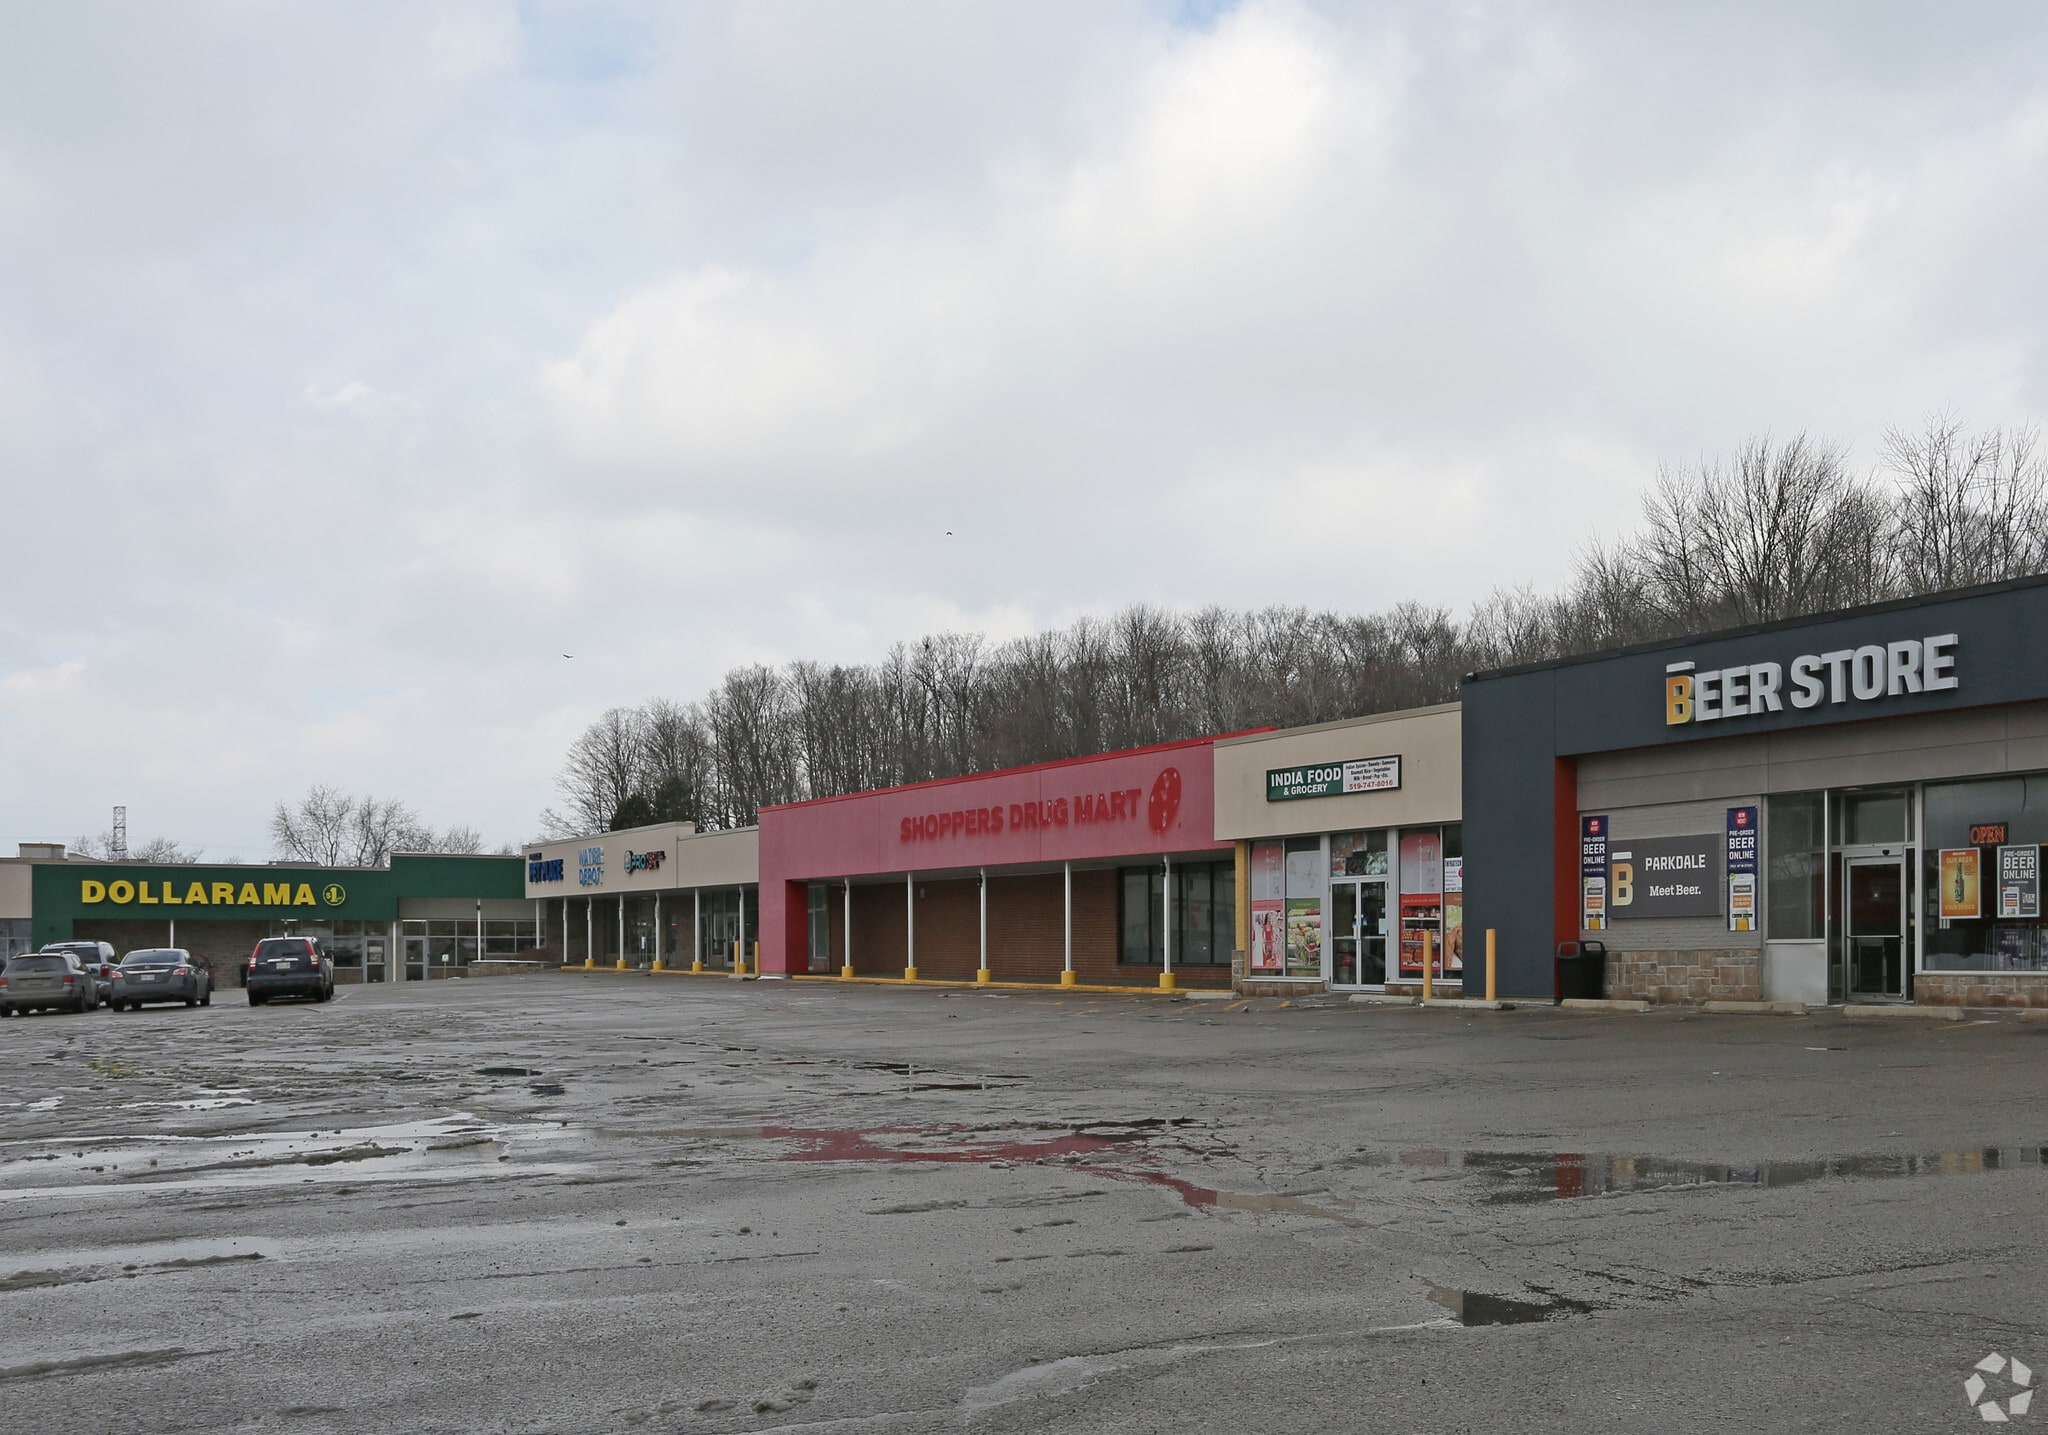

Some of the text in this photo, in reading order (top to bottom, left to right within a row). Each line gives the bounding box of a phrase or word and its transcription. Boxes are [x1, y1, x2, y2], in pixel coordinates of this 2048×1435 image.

[1666, 633, 1958, 725] BEER STORE
[1271, 767, 1342, 787] INDIA FOOD
[1283, 783, 1328, 796] & GROCERY
[901, 788, 1142, 842] SHOPPERS DRUG MART
[1729, 837, 1755, 849] BEER
[1970, 826, 2005, 845] OPEN
[578, 847, 604, 866] WATER
[1583, 844, 1606, 855] BEER
[1729, 850, 1755, 860] ONLINE
[1583, 856, 1606, 865] ONLINE
[1645, 854, 1706, 871] PARKDALE
[2004, 857, 2035, 869] BEER
[579, 867, 604, 885] DEPOT
[2003, 869, 2035, 879] ONLINE
[81, 880, 317, 906] DOLLARAMA
[1649, 884, 1702, 897] Meet Beer.
